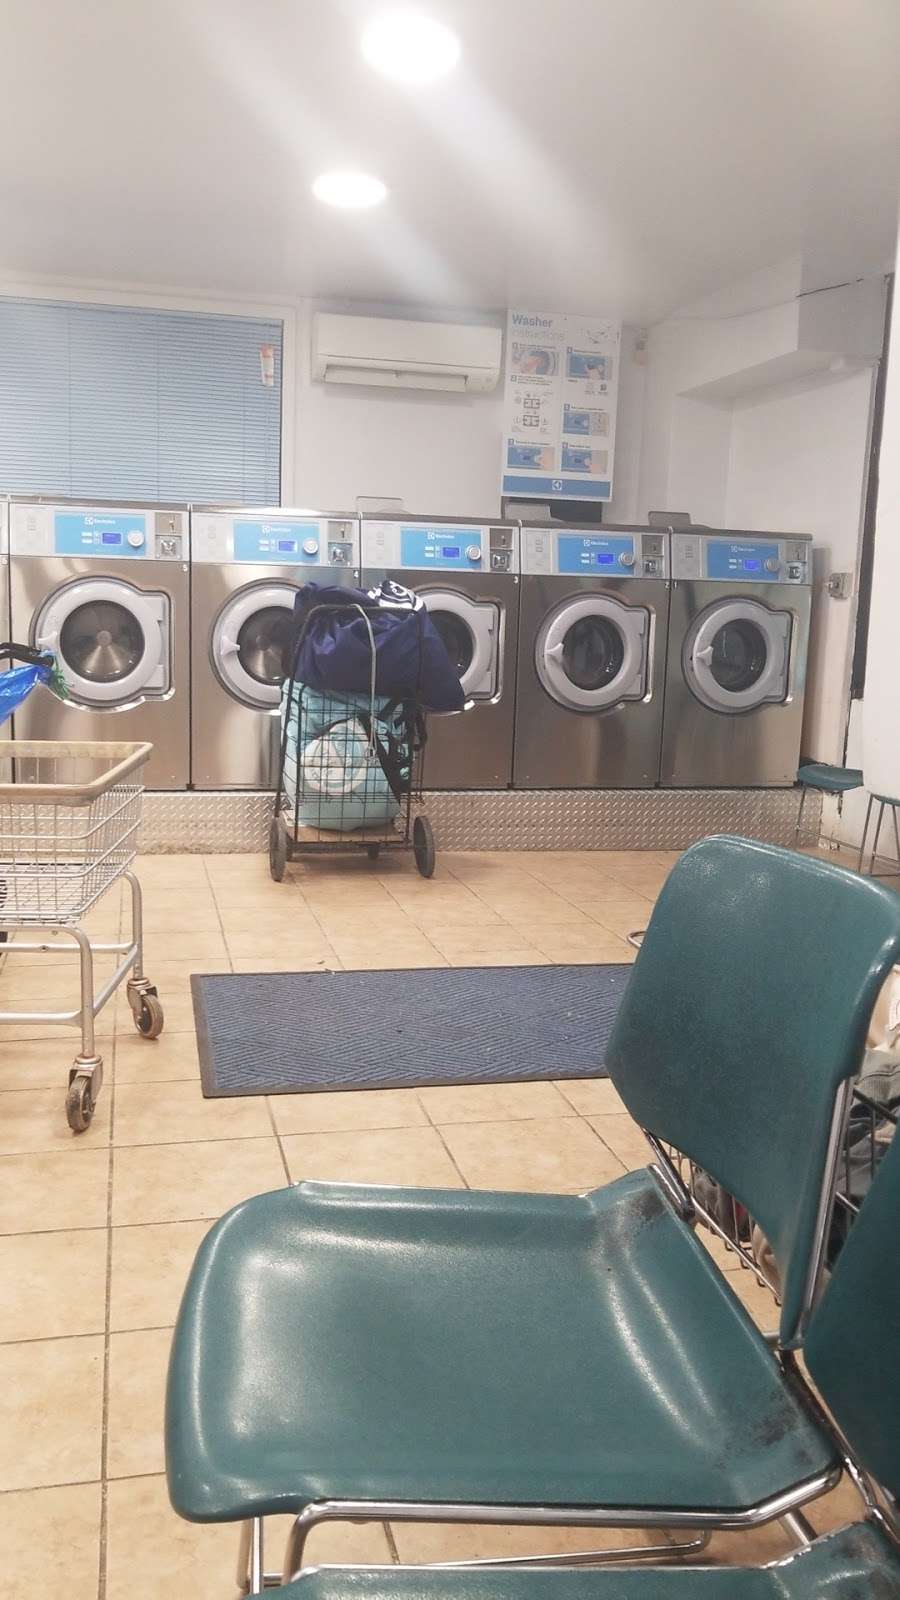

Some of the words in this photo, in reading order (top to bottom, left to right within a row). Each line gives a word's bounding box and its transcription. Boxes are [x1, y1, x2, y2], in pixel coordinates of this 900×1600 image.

[512, 313, 554, 328] Washer
[182, 563, 188, 572] 5
[353, 570, 360, 578] 4
[513, 575, 519, 584] 3
